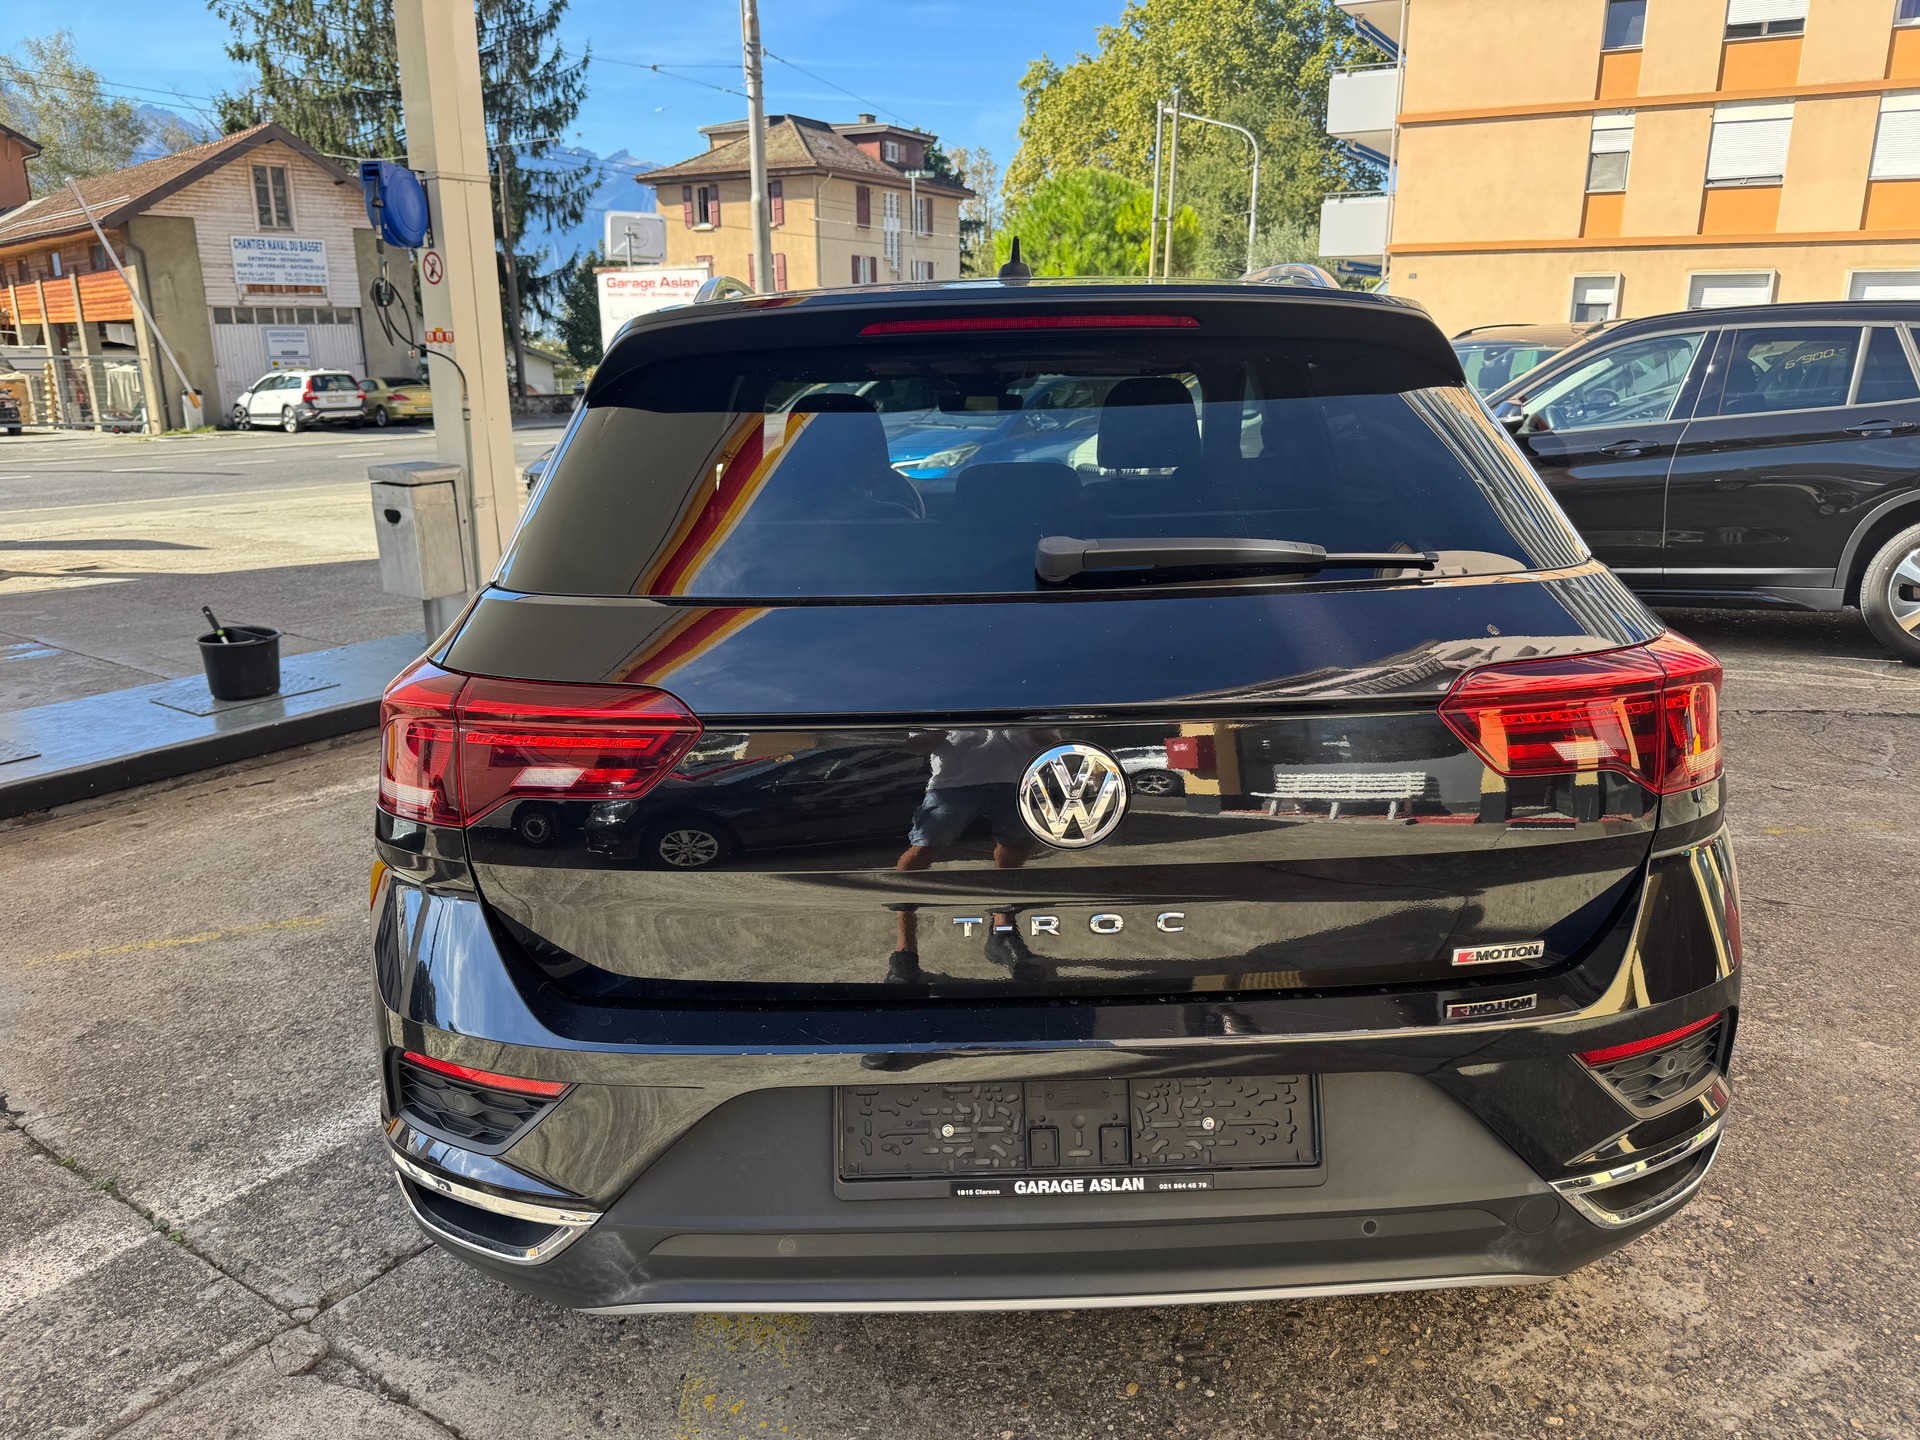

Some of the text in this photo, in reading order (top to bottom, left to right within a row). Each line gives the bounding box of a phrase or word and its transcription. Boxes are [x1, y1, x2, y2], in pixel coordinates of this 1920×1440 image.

[233, 238, 266, 250] CHANTIER
[289, 240, 298, 252] DU
[299, 241, 323, 253] BASSET
[606, 277, 700, 291] Garage Aslan
[1014, 1179, 1084, 1194] GARAGE
[1089, 1177, 1144, 1191] ASLAN
